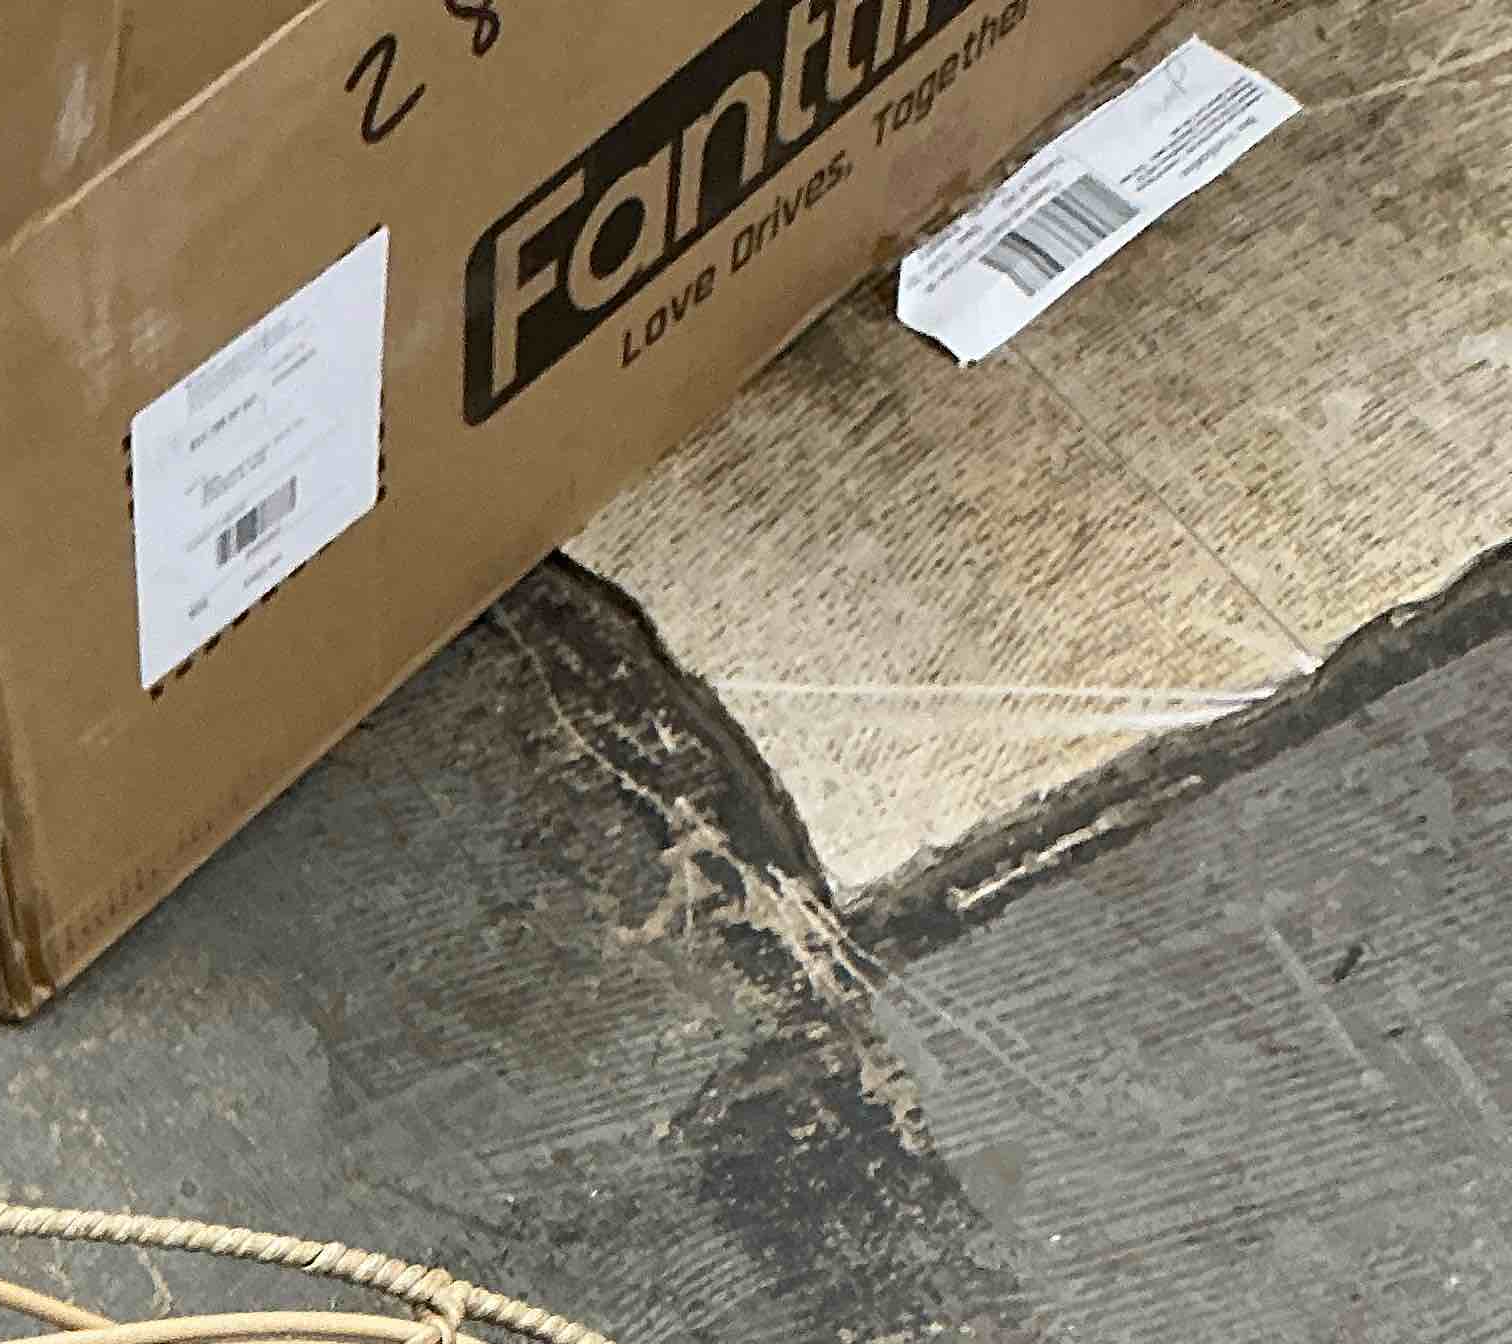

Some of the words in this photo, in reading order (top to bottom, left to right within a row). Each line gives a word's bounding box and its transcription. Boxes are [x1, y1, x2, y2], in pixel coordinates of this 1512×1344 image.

[343, 32, 427, 143] 2
[490, 0, 930, 397] Fantti
[620, 265, 717, 368] Love
